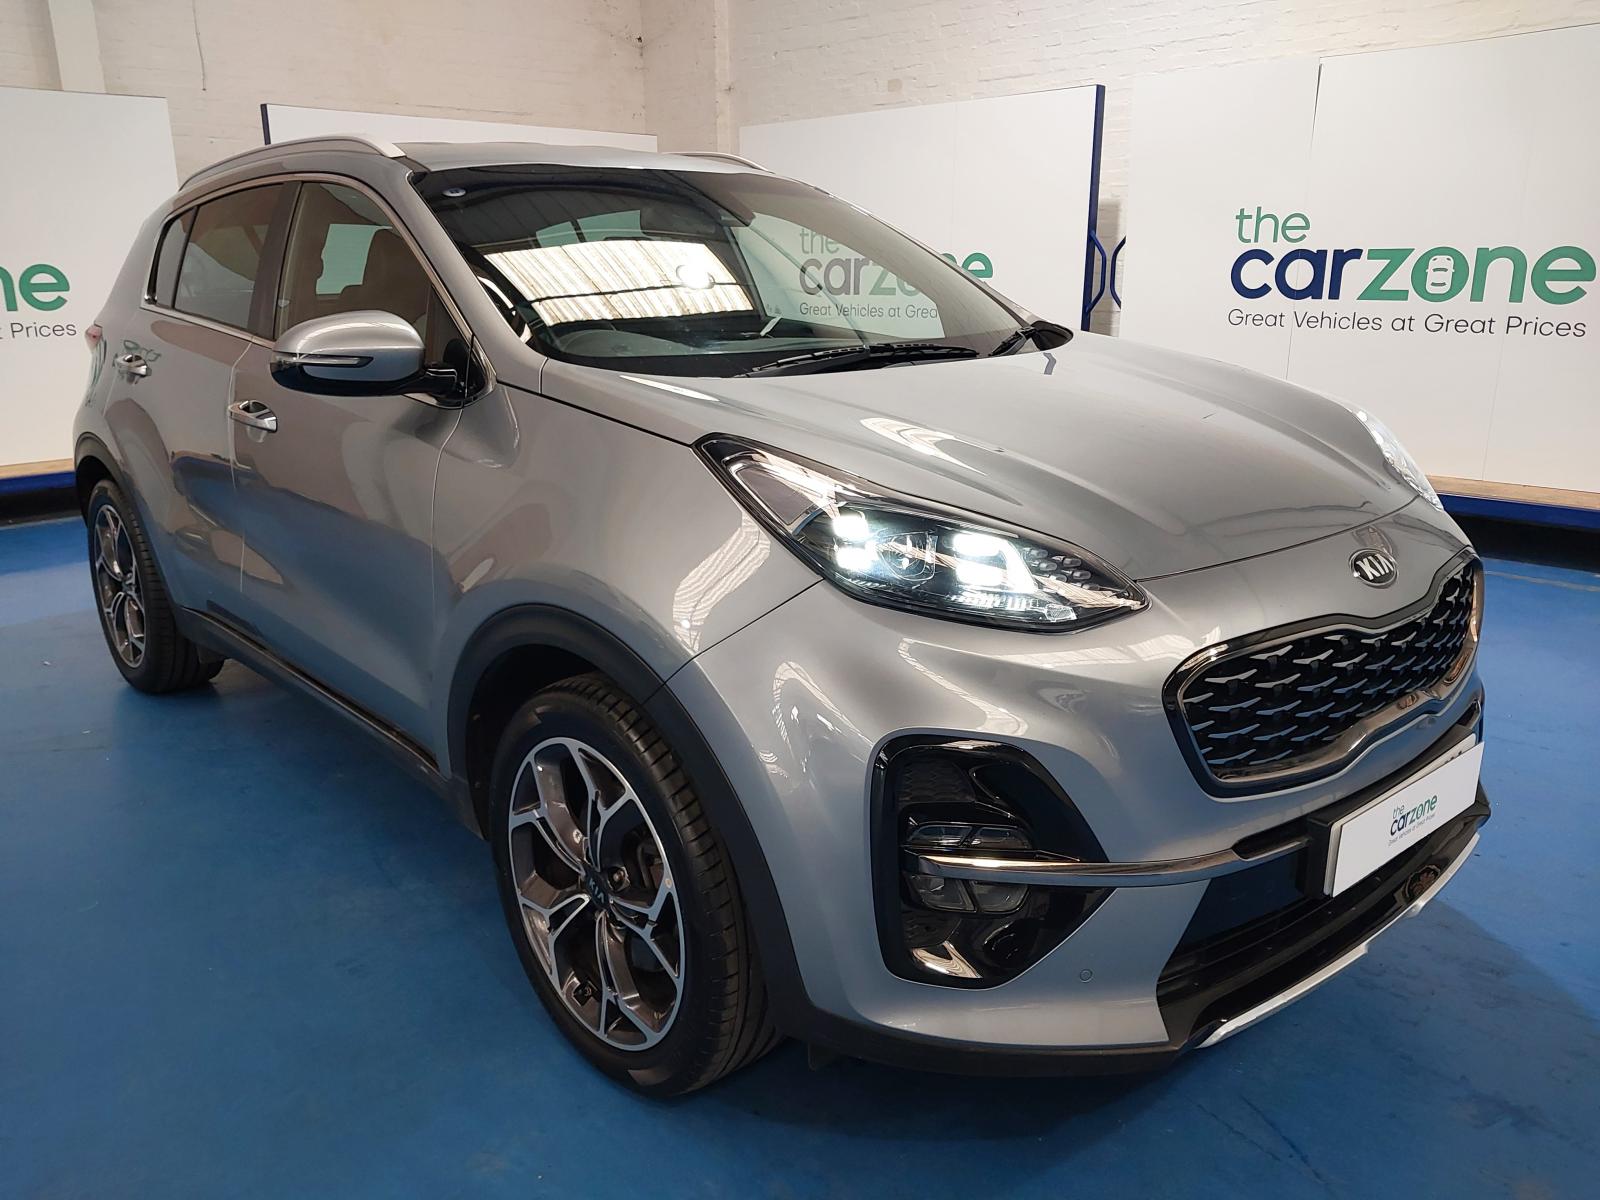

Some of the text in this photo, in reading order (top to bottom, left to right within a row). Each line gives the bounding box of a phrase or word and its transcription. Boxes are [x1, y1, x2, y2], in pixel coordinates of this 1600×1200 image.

[1235, 206, 1311, 244] the
[1230, 245, 1597, 306] carzone
[800, 302, 938, 319] Great Vehicles at Grea
[1228, 308, 1587, 338] Great Vehicles at Great Prices
[10, 322, 77, 338] Prices
[1355, 553, 1394, 581] KIA
[1390, 794, 1438, 836] carzone
[1392, 804, 1405, 819] the
